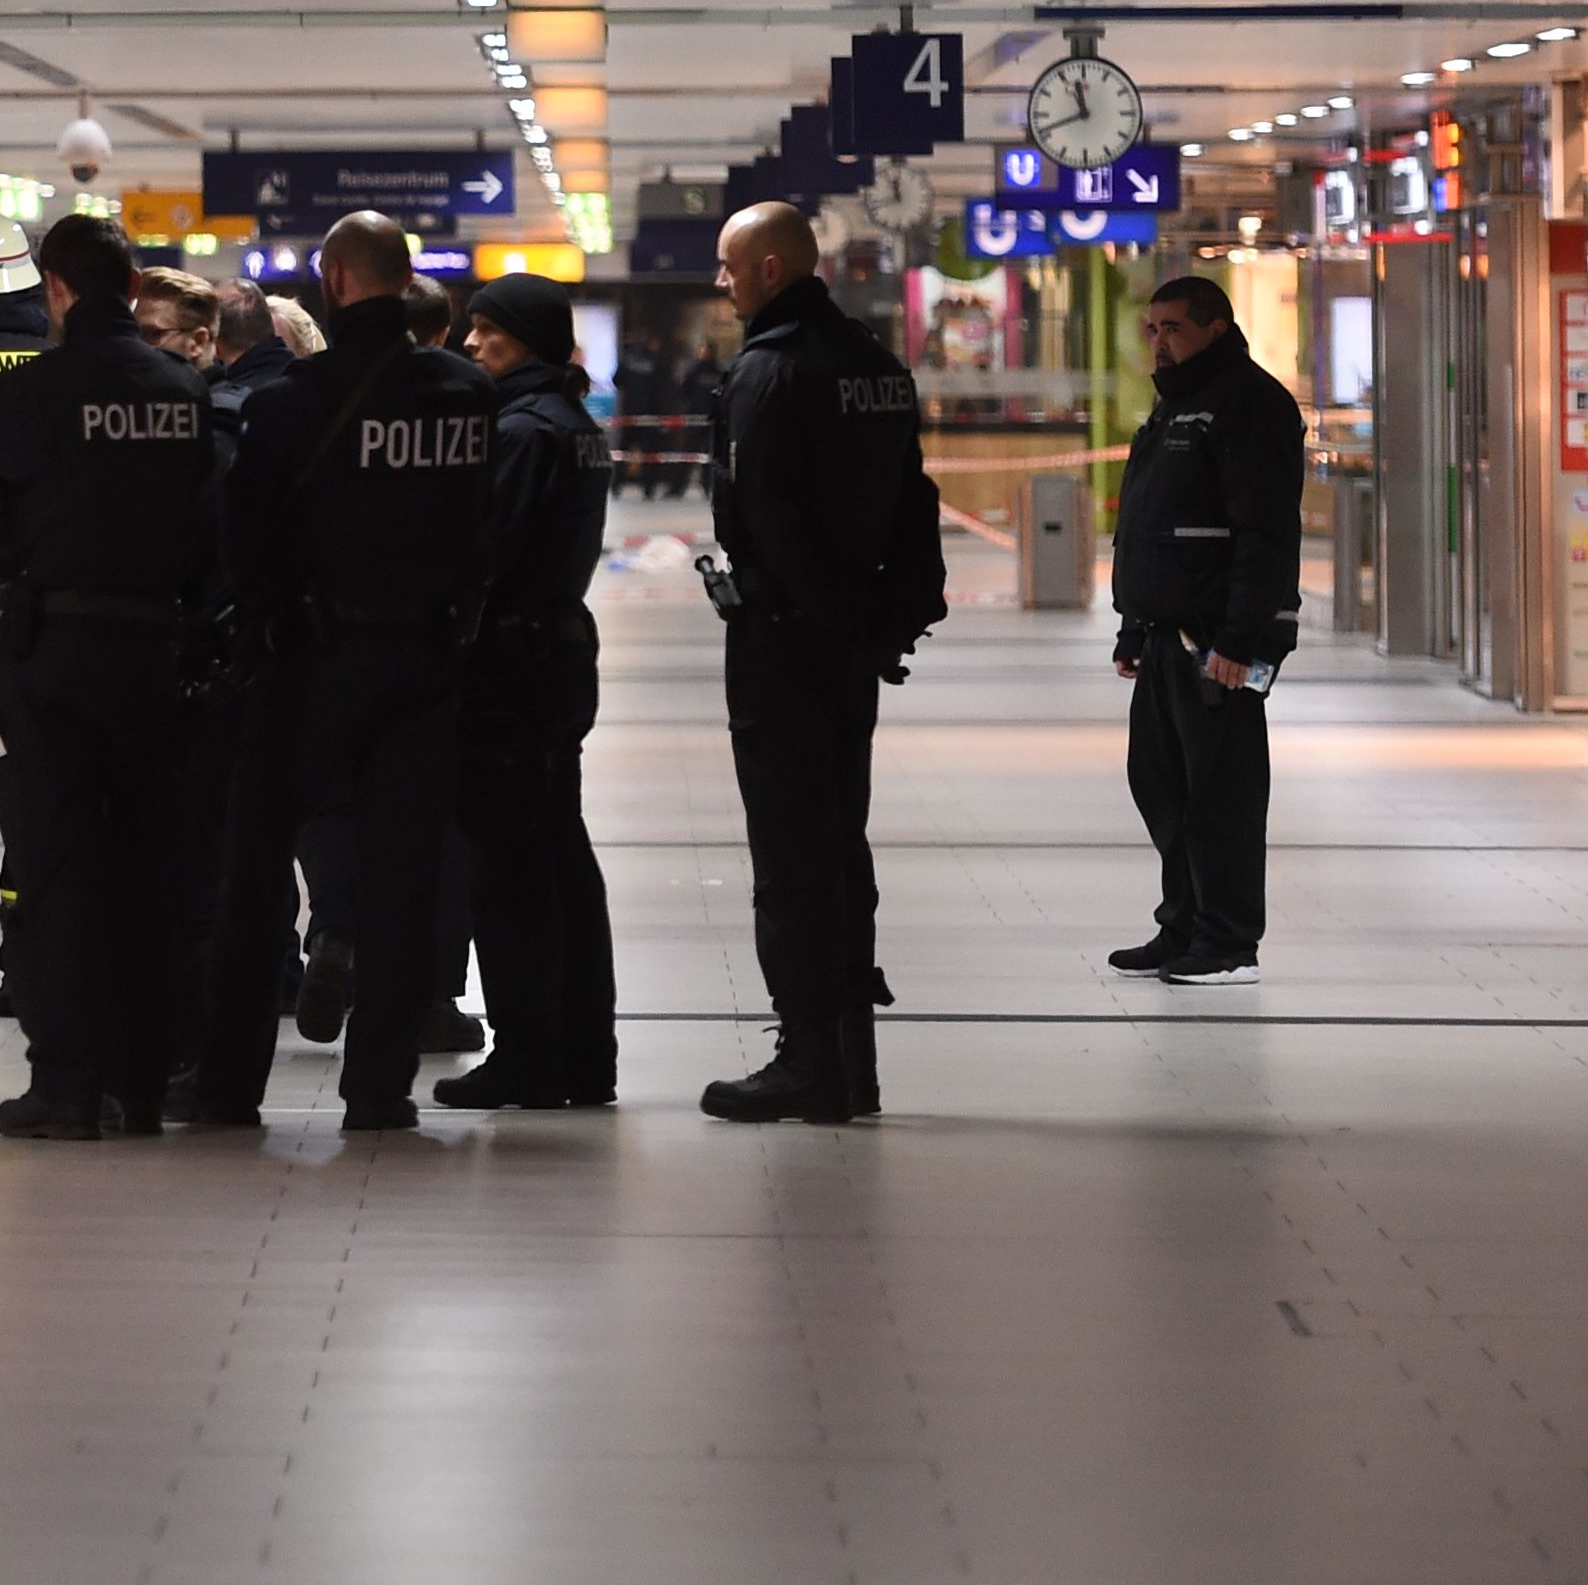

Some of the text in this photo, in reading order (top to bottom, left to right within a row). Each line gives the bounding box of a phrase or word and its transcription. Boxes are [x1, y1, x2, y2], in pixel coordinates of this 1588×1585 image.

[903, 38, 949, 107] 4
[1007, 154, 1034, 186] U
[83, 403, 199, 440] POLIZEI
